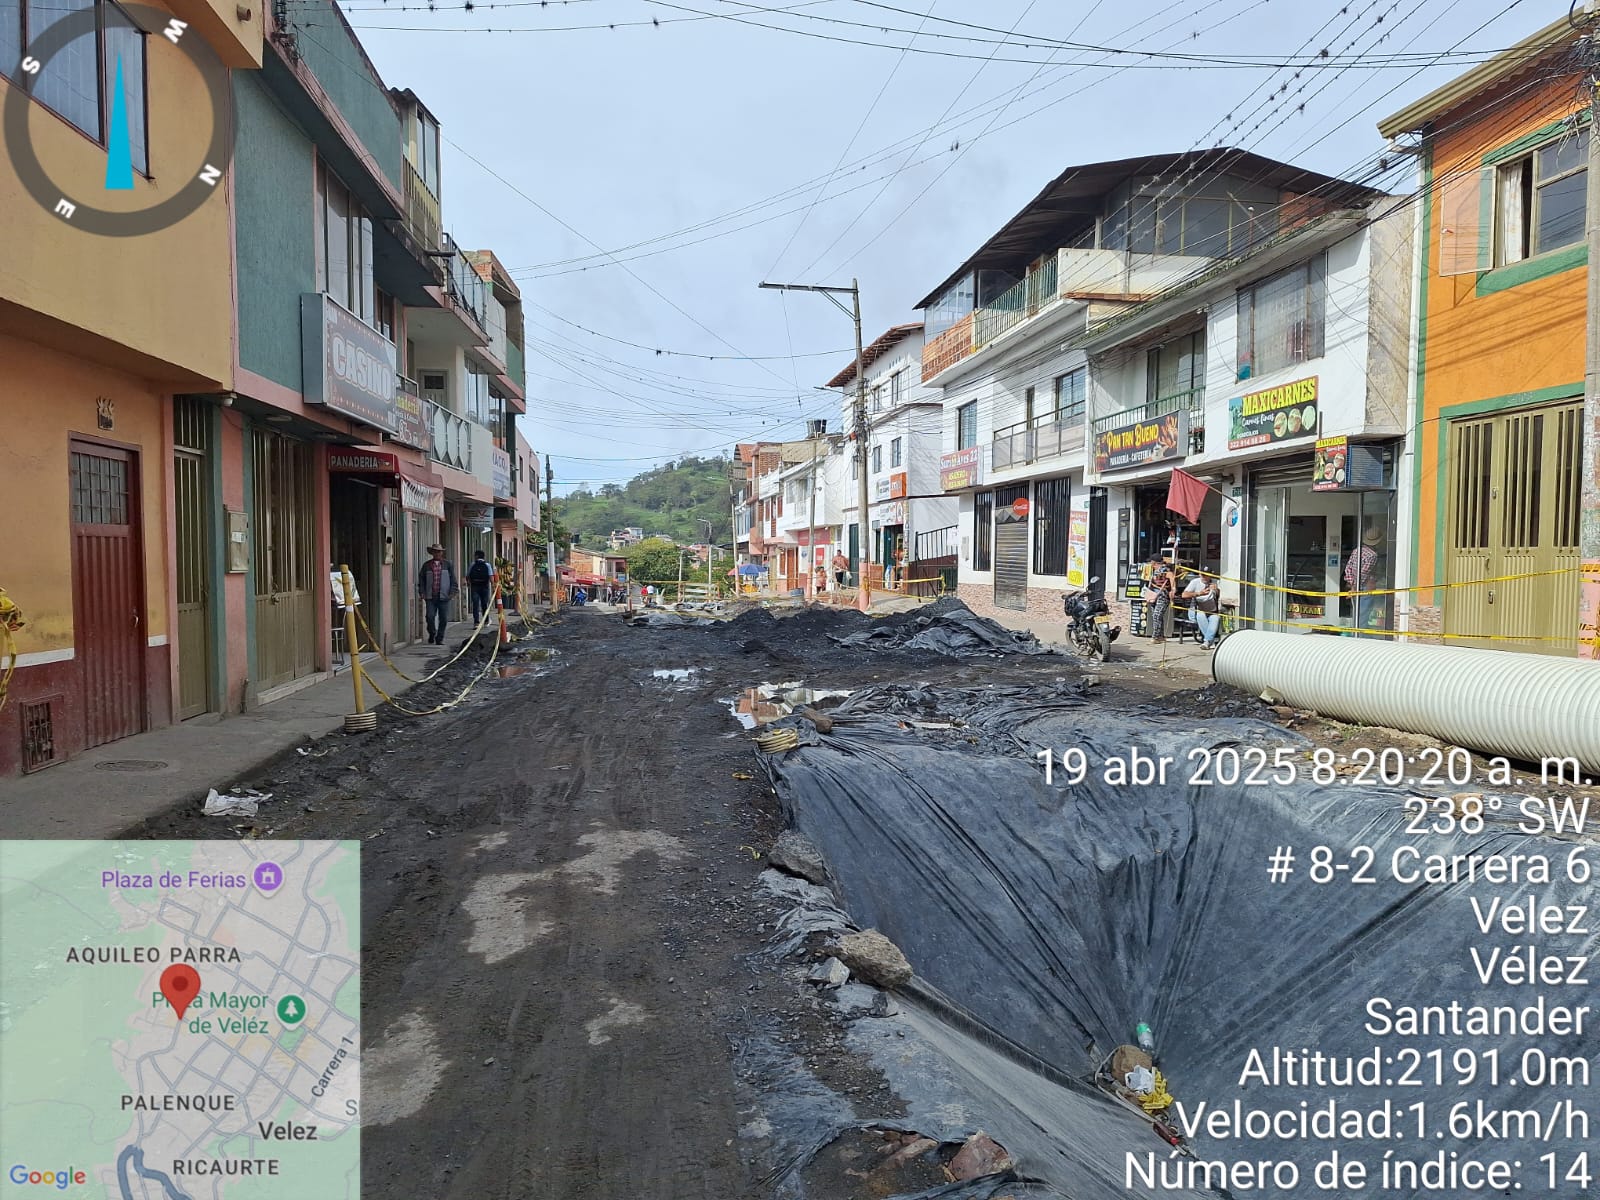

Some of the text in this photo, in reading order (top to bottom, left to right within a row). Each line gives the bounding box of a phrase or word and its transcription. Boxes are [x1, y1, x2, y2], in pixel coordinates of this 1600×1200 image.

[332, 334, 392, 402] CASINO
[1242, 377, 1316, 417] MAXICARNES
[1135, 423, 1160, 448] BUENO
[331, 455, 379, 468] PANADERIA
